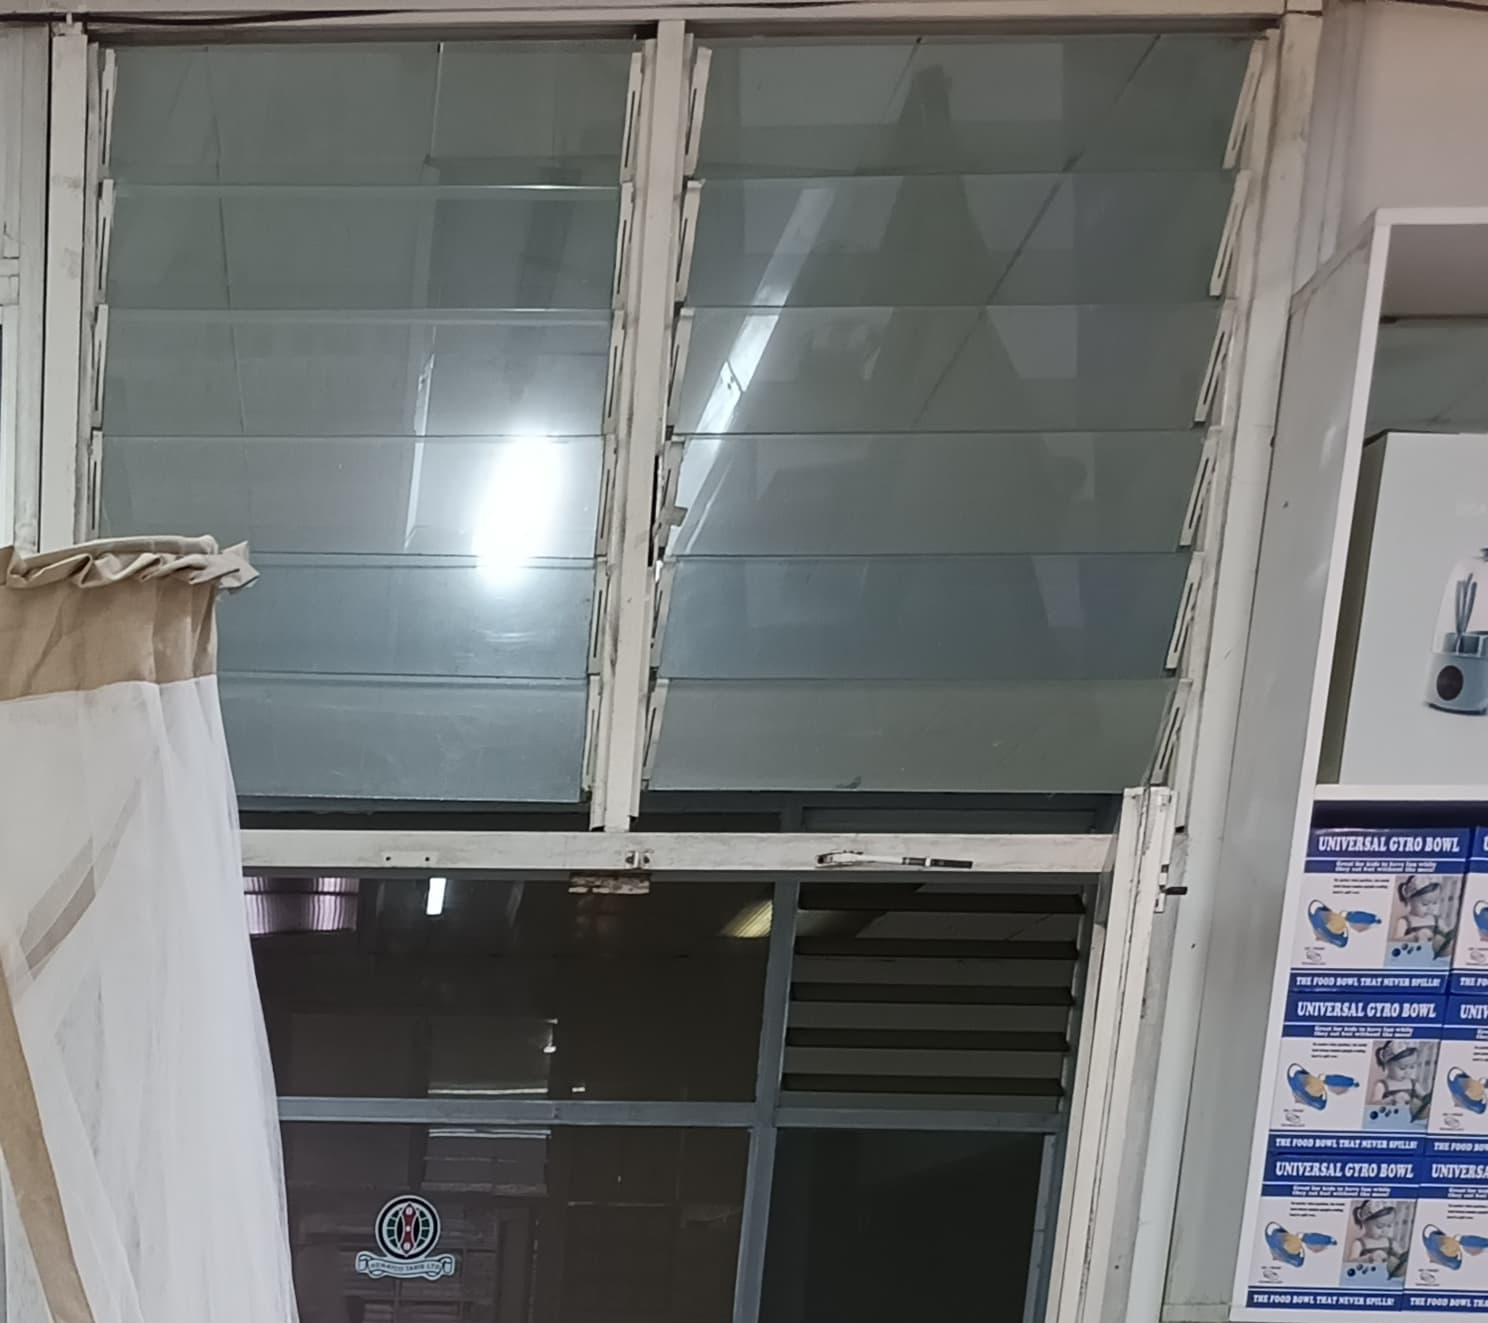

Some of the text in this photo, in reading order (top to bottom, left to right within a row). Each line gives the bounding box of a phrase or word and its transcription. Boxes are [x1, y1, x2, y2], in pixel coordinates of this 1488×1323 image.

[1318, 836, 1460, 852] UNIVERSAL GYRO BOWL
[1296, 977, 1311, 986] THE
[1313, 977, 1334, 986] FOOD
[1336, 978, 1358, 986] BOWL
[1360, 978, 1382, 986] THAT
[1384, 978, 1410, 987] NEVER
[1460, 978, 1475, 986] THE
[1297, 1002, 1436, 1018] UNIVERSAL GYRO BOWL
[1276, 1138, 1291, 1146] THE
[1292, 1139, 1313, 1147] FOOD
[1315, 1139, 1337, 1148] BOWL
[1339, 1140, 1360, 1148] THAT
[1362, 1140, 1388, 1148] NEVER
[1434, 1142, 1449, 1150] THE
[1450, 1142, 1472, 1151] FOOD
[1276, 1162, 1414, 1178] UNIVERSAL GYRO BOWL
[1292, 1296, 1315, 1304] BOWL
[1316, 1296, 1337, 1304] THAT
[1339, 1296, 1365, 1305] NEVER
[1426, 1298, 1448, 1306] FOOD
[1450, 1298, 1471, 1306] BOWL
